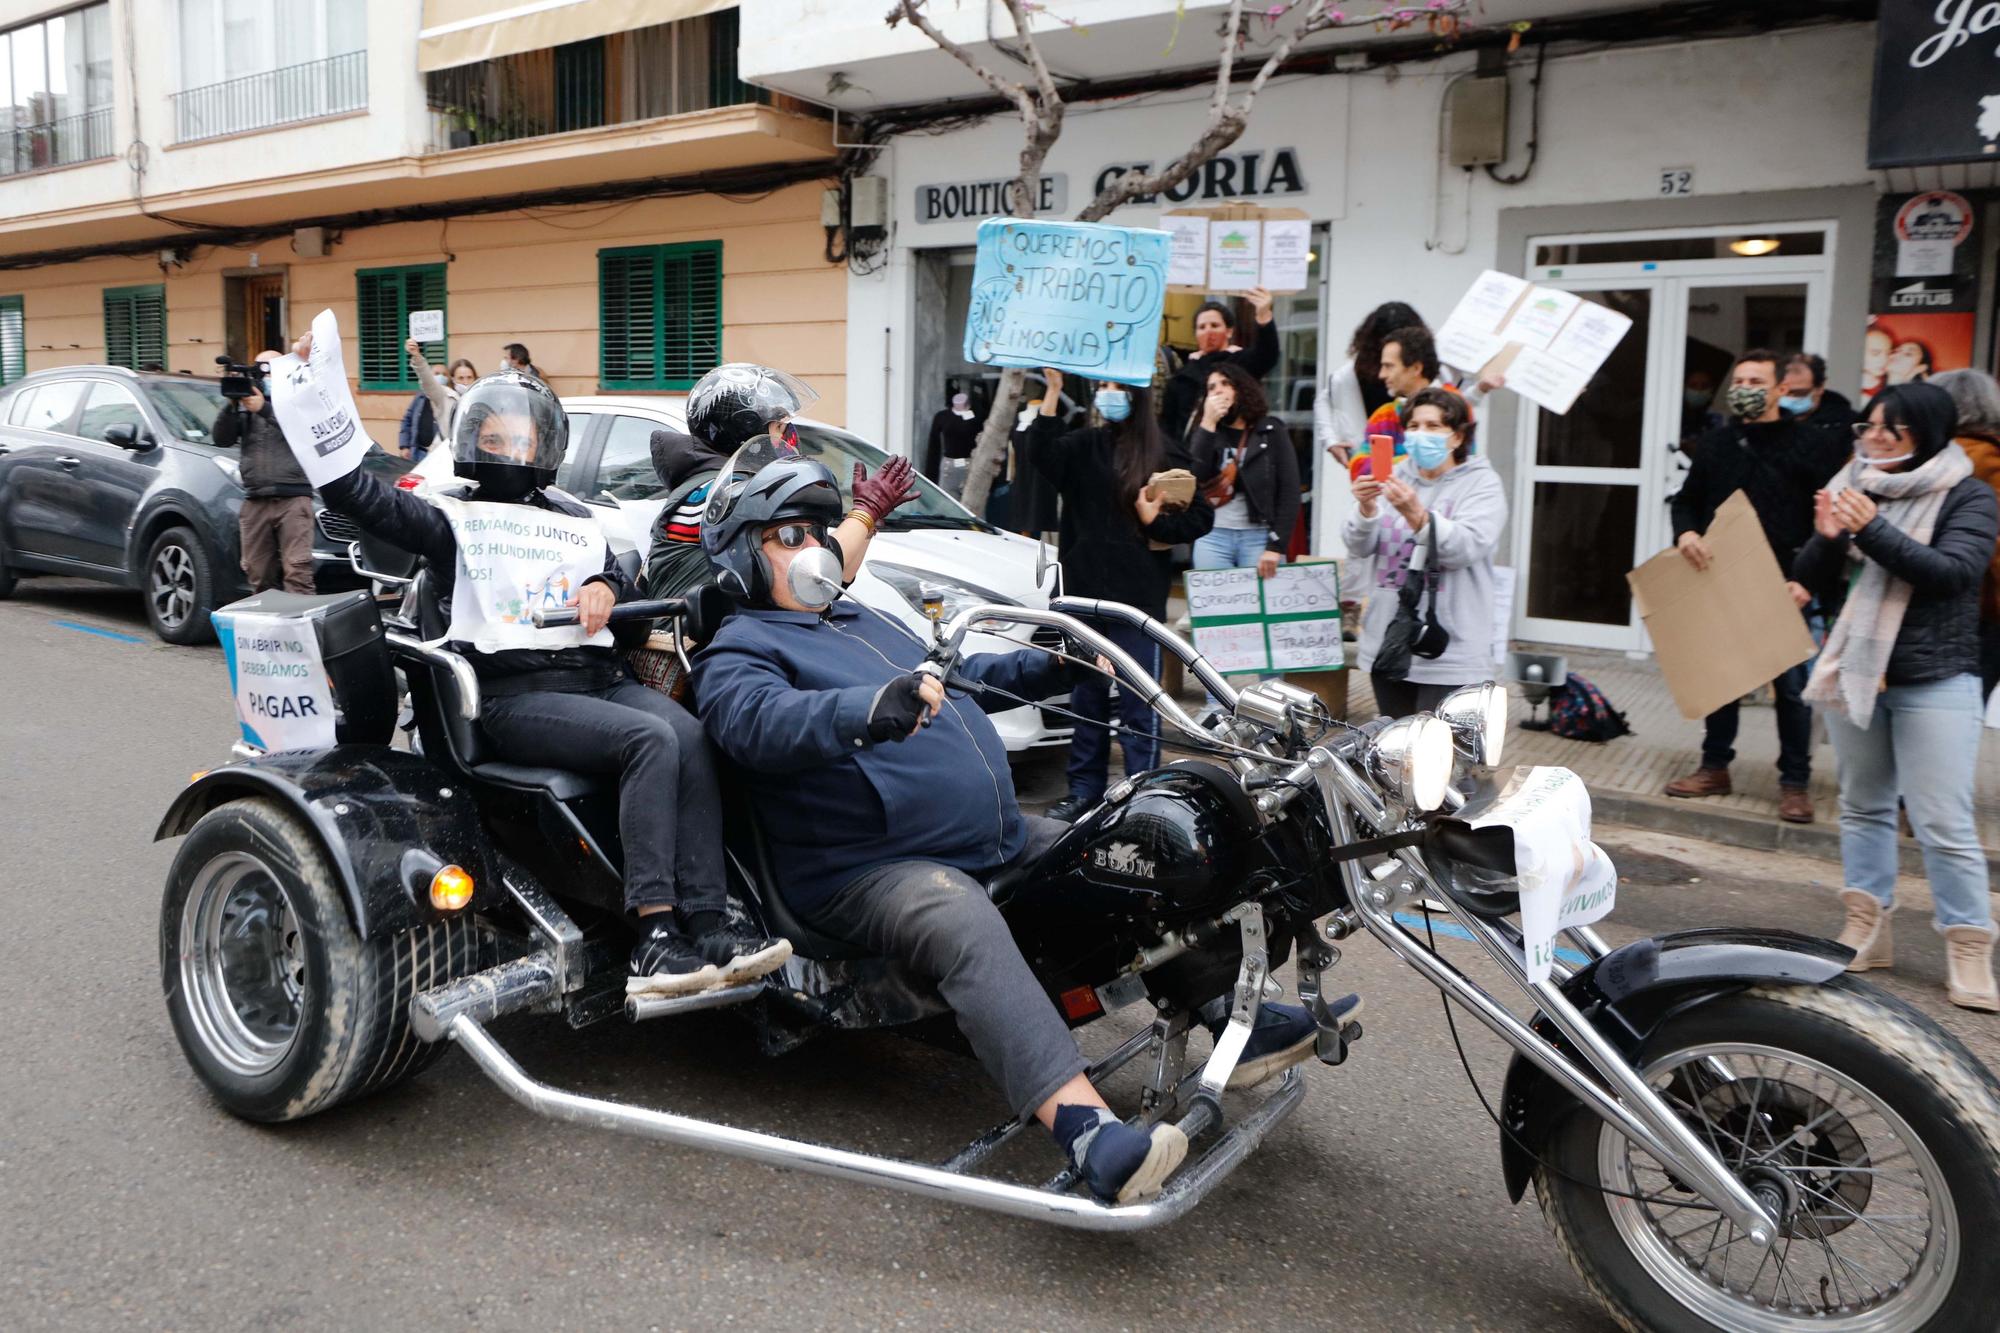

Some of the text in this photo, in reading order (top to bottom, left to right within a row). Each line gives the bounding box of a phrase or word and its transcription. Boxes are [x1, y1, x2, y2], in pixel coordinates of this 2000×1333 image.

[1661, 171, 1691, 194] 52
[1013, 231, 1121, 265] QUEREMOS
[1023, 266, 1148, 313] TRABAJO
[1889, 293, 1953, 307] LOTUS
[464, 519, 530, 537] REMAMOS
[534, 525, 588, 547] JUNTOS
[488, 543, 564, 564] HUNDIMOS
[237, 636, 303, 653] SIN ABRIR NO
[241, 660, 308, 678] DEBERÍAMOS
[249, 691, 318, 719] PAGAR
